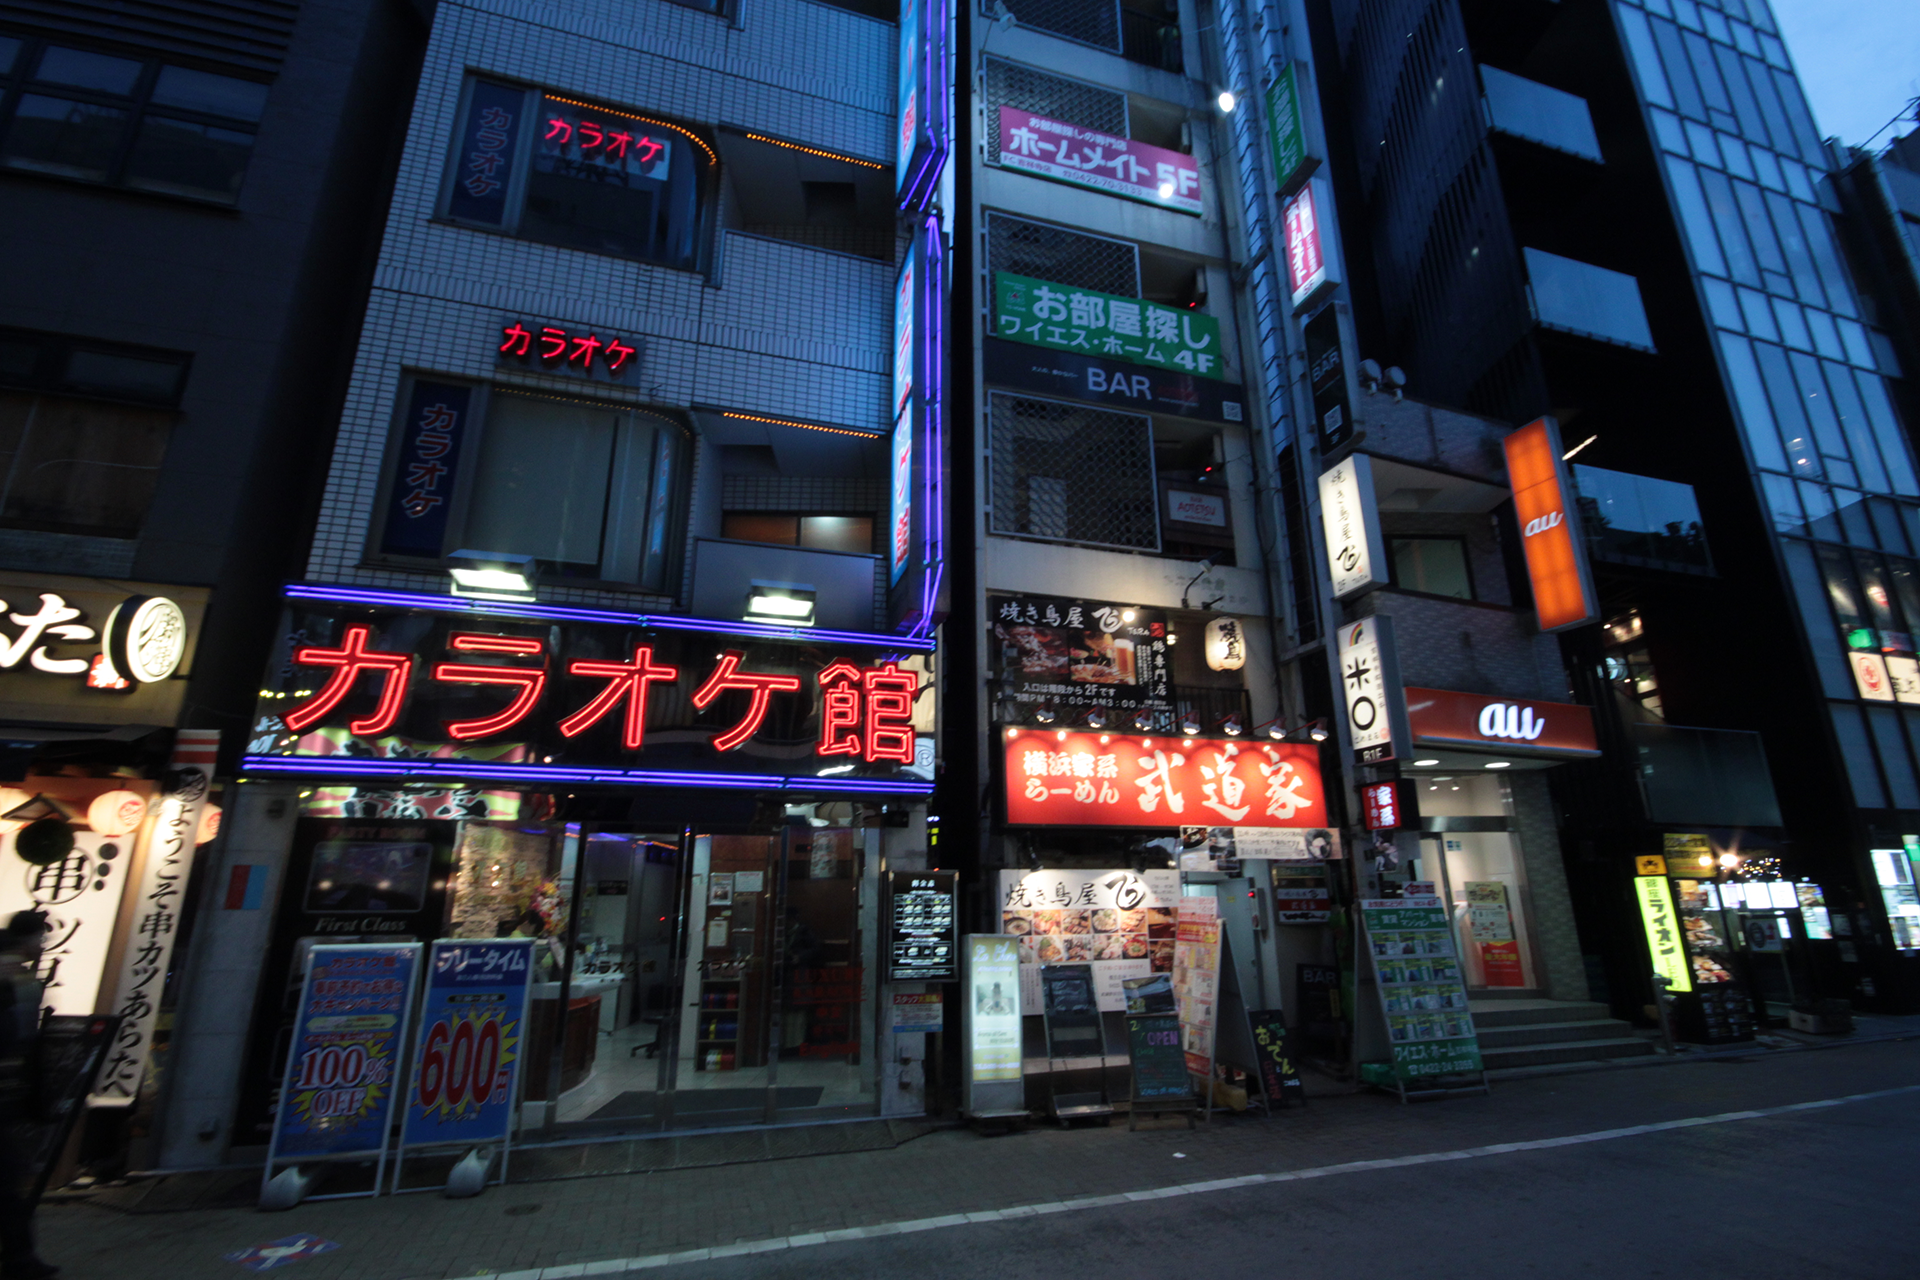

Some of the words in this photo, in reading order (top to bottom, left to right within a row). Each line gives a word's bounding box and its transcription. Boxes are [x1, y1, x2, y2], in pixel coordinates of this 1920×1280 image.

[469, 106, 513, 197] カラオケ
[544, 115, 665, 163] カラオケ
[1009, 126, 1151, 184] ホームメイト
[1156, 161, 1198, 195] 5F
[1032, 285, 1211, 350] お部屋探し
[499, 321, 637, 377] カラオケ
[1000, 314, 1165, 364] ワイエス・ホーム
[1173, 349, 1215, 374] 4F
[1087, 367, 1152, 400] BAR
[1312, 351, 1340, 383] BAR
[402, 402, 458, 519] カラオケ
[1524, 511, 1564, 537] au
[1000, 601, 1085, 629] 焼き鳥屋
[280, 622, 918, 765] カラオケ館
[1479, 703, 1546, 741] au
[1023, 751, 1119, 779] 横浜家系
[1135, 743, 1313, 822] 武道家
[1025, 778, 1120, 805] らーめん
[1005, 881, 1099, 908] 焼き鳥屋
[102, 803, 196, 1099] ようこそ串カツあらたへ
[438, 947, 526, 974] フリータイム
[1303, 968, 1336, 985] BAR
[1147, 1031, 1179, 1046] OPEN
[296, 1045, 388, 1090] 100%
[309, 1088, 366, 1117] OFF
